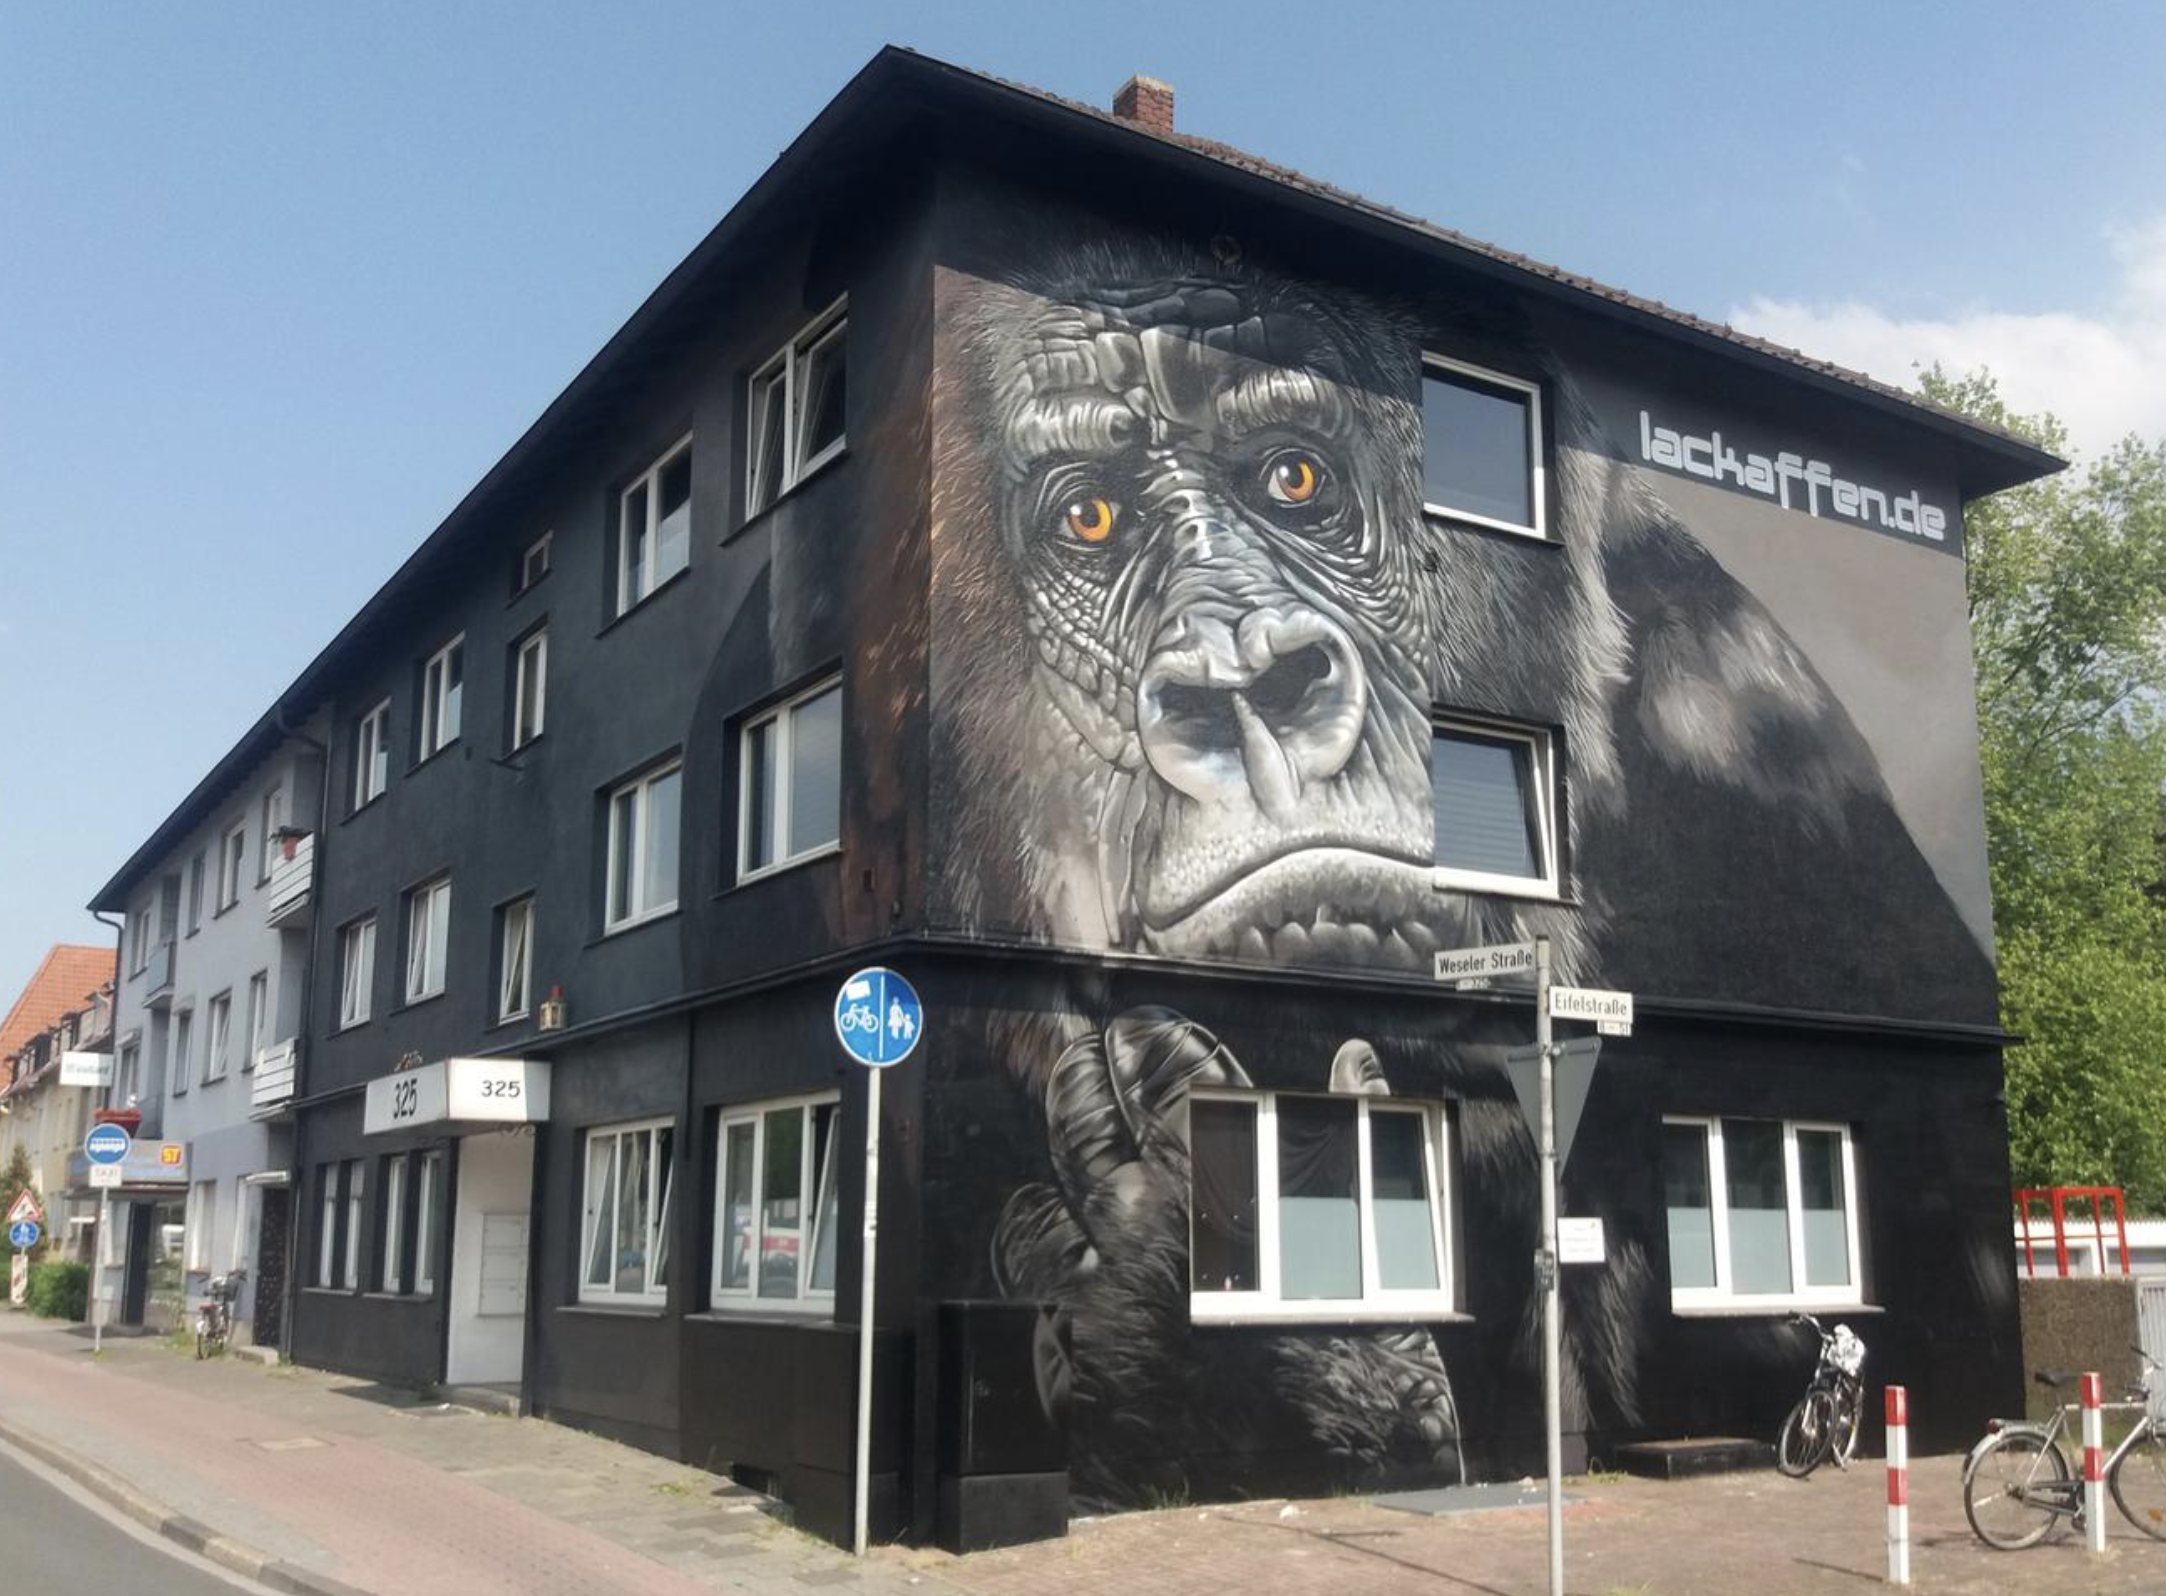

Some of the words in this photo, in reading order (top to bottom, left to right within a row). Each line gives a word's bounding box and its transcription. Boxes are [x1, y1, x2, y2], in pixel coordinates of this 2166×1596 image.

[1640, 410, 1946, 540] lackaffen.de
[1439, 955, 1486, 974] Weseler
[1491, 949, 1533, 969] Straße
[1555, 992, 1627, 1016] Eifelstraße
[393, 1078, 418, 1119] 325
[481, 1080, 521, 1098] 325
